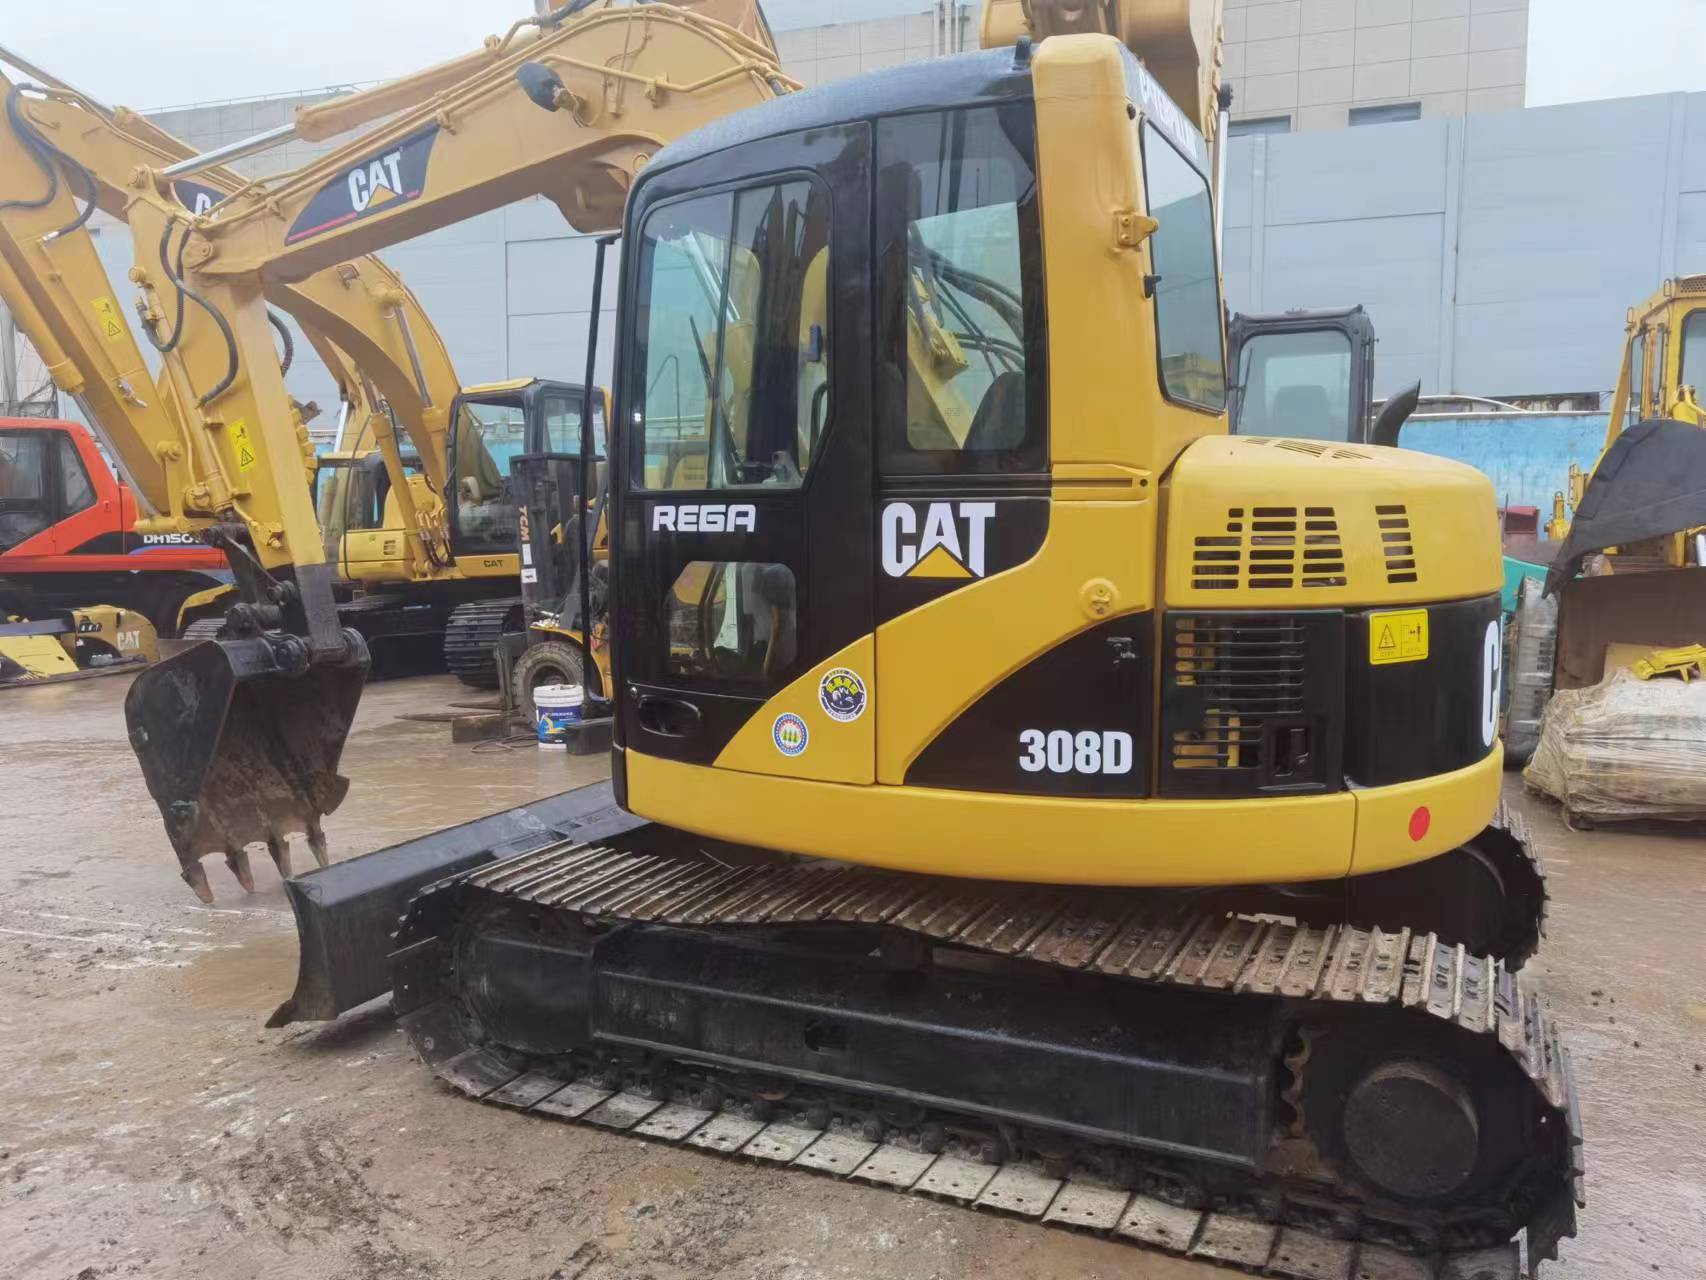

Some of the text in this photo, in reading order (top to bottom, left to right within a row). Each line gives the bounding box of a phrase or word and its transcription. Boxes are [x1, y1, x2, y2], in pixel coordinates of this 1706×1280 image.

[348, 151, 403, 212] CAT
[518, 505, 530, 541] TCM
[652, 504, 756, 532] REGA
[881, 502, 996, 578] CAT
[483, 560, 504, 568] CAT
[117, 630, 141, 651] CAT
[1019, 729, 1133, 774] 308D
